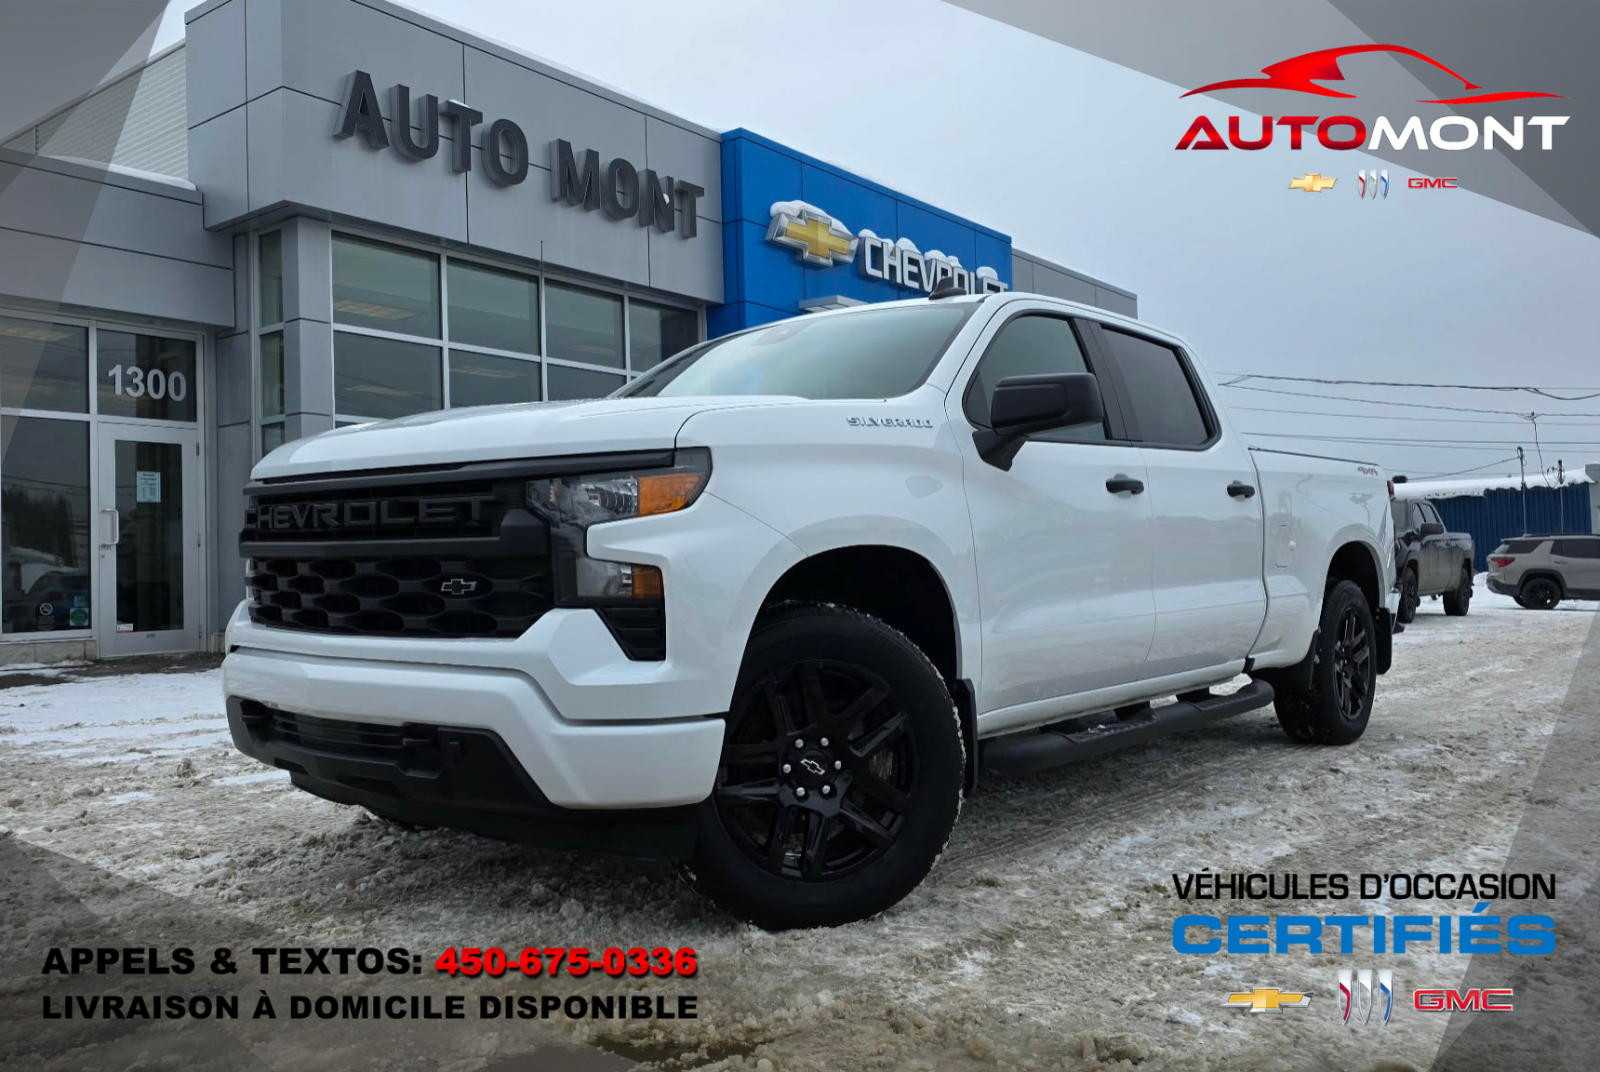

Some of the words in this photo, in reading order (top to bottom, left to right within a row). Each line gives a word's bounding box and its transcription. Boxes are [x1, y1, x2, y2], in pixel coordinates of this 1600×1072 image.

[332, 69, 529, 188] AUTO
[550, 138, 705, 239] MONT
[107, 363, 187, 401] 1300
[244, 495, 497, 529] CHEVROLET
